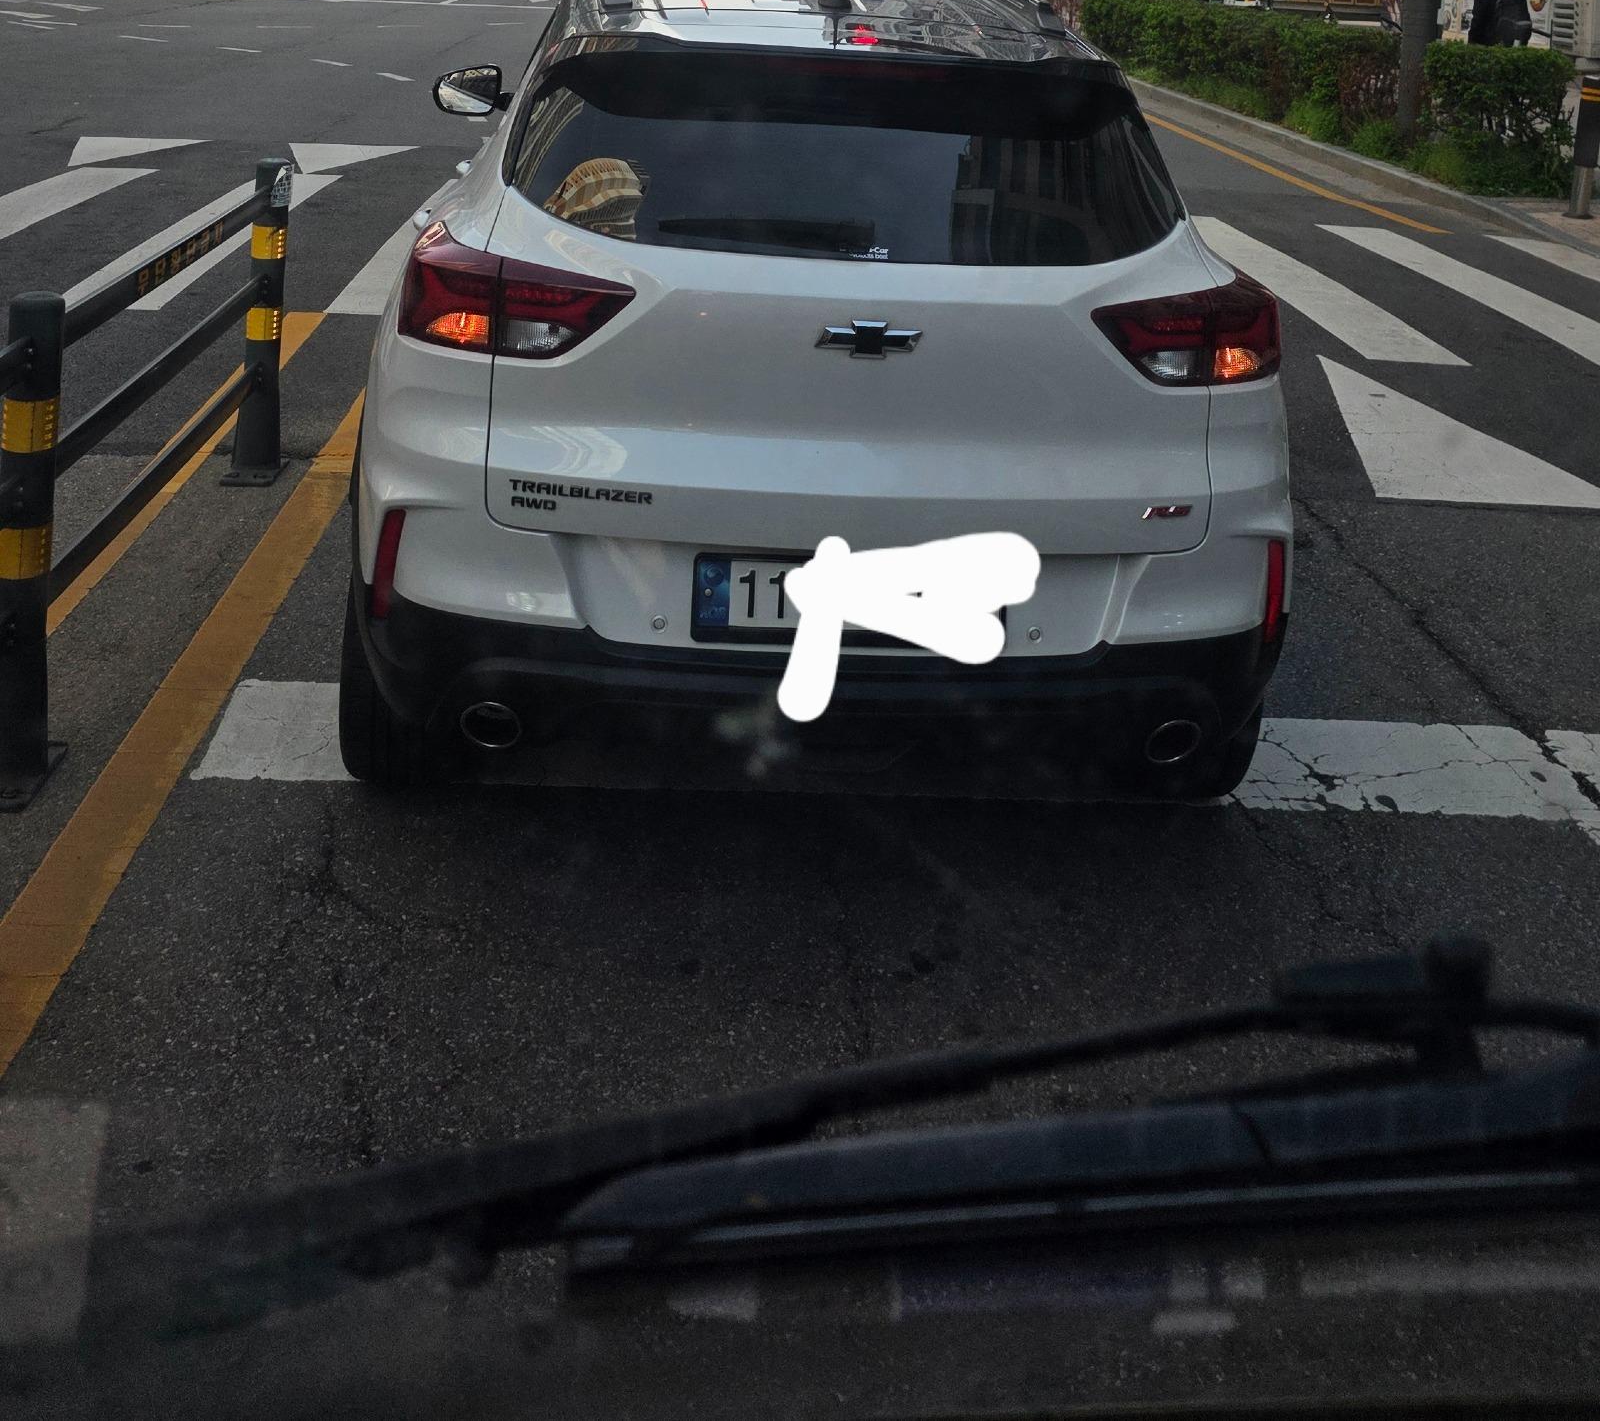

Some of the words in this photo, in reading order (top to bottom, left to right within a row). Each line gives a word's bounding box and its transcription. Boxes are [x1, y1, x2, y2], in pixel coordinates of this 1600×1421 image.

[509, 479, 653, 505] TRAILBLAZER
[511, 496, 557, 511] AWD
[1142, 505, 1193, 519] RS
